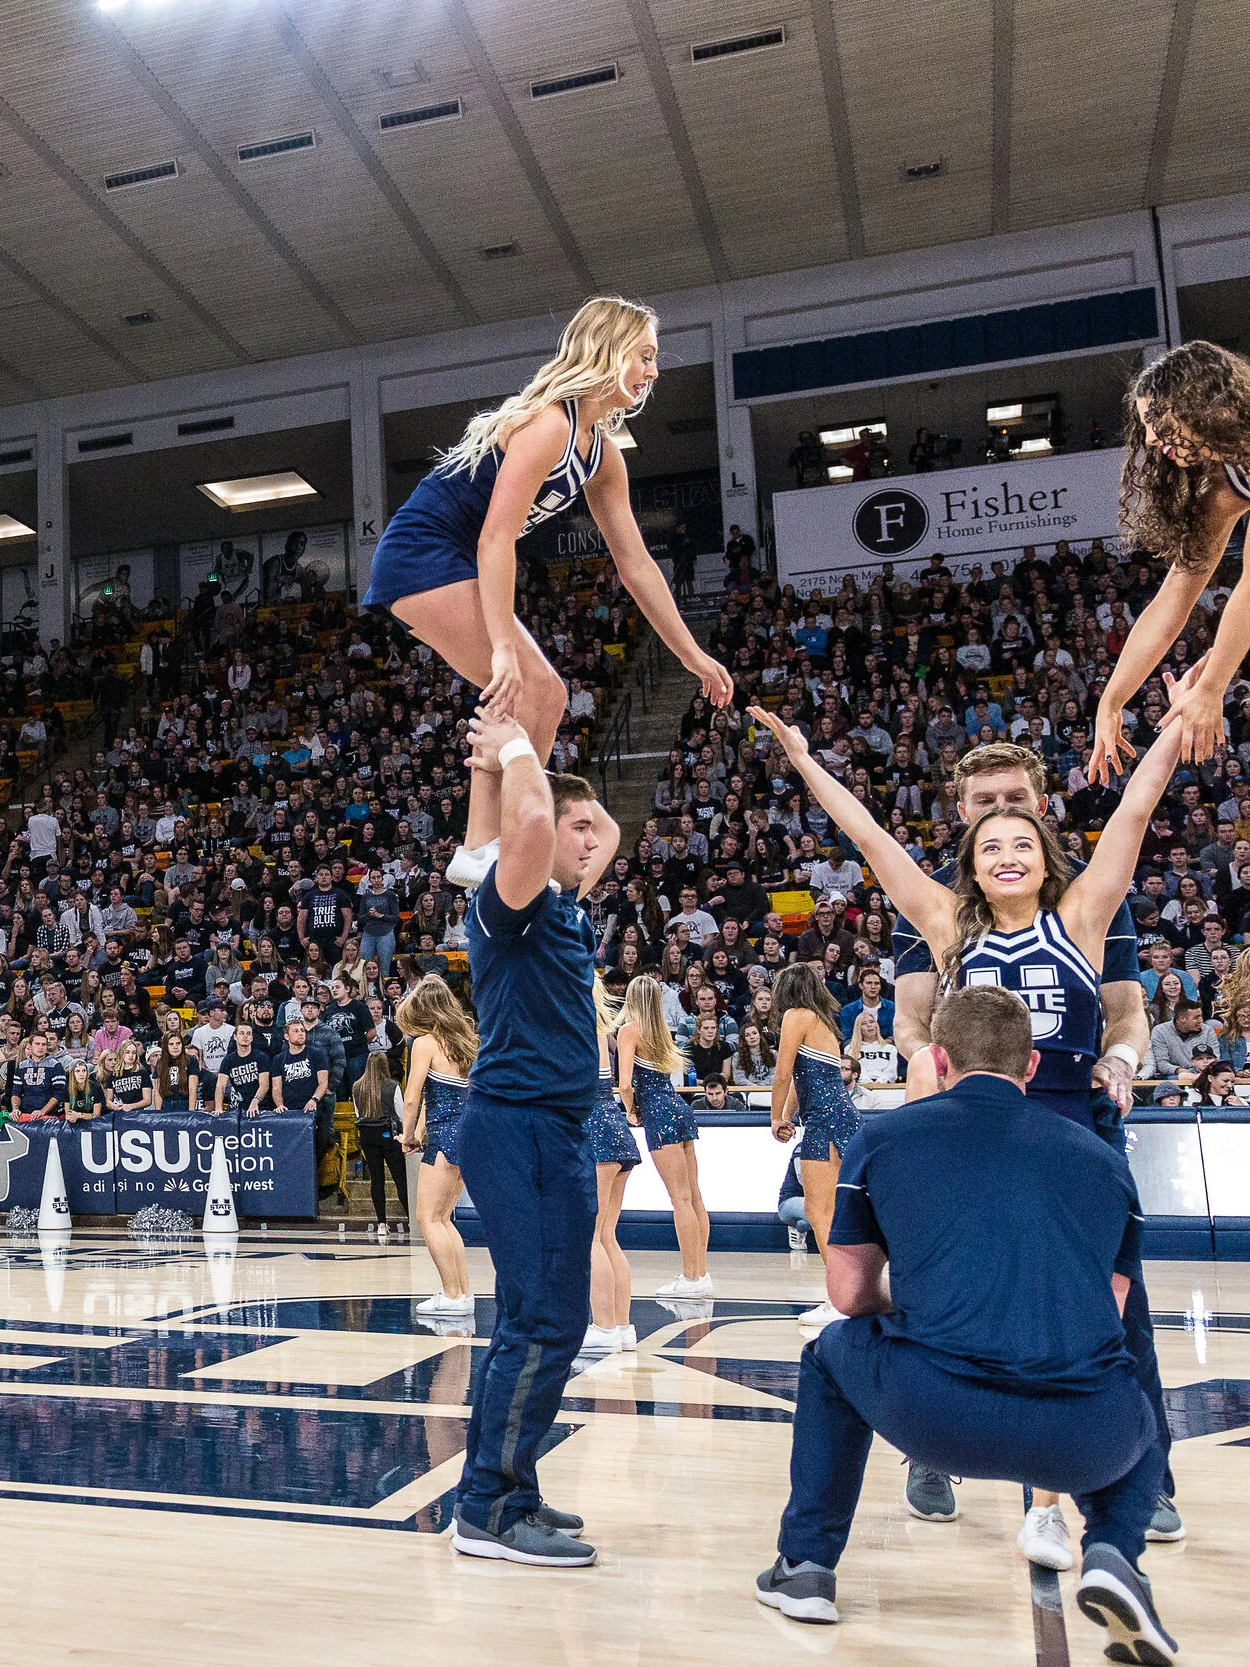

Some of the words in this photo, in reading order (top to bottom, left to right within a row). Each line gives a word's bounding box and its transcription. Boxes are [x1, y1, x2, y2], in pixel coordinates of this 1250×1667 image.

[732, 472, 745, 488] L
[940, 480, 1068, 524] Fisher
[362, 520, 376, 536] K
[874, 502, 906, 542] F
[936, 524, 984, 540] Home
[988, 512, 1078, 534] Furnishings
[46, 564, 54, 578] J
[800, 577, 826, 588] 2175
[828, 574, 859, 584] Noh
[312, 906, 337, 916] TRUE
[314, 914, 336, 925] BLUE
[112, 1076, 142, 1088] AGGIES
[122, 1083, 141, 1092] WAY
[196, 1128, 272, 1150] Credit
[80, 1130, 190, 1174] USU
[210, 1203, 232, 1212] STATE
